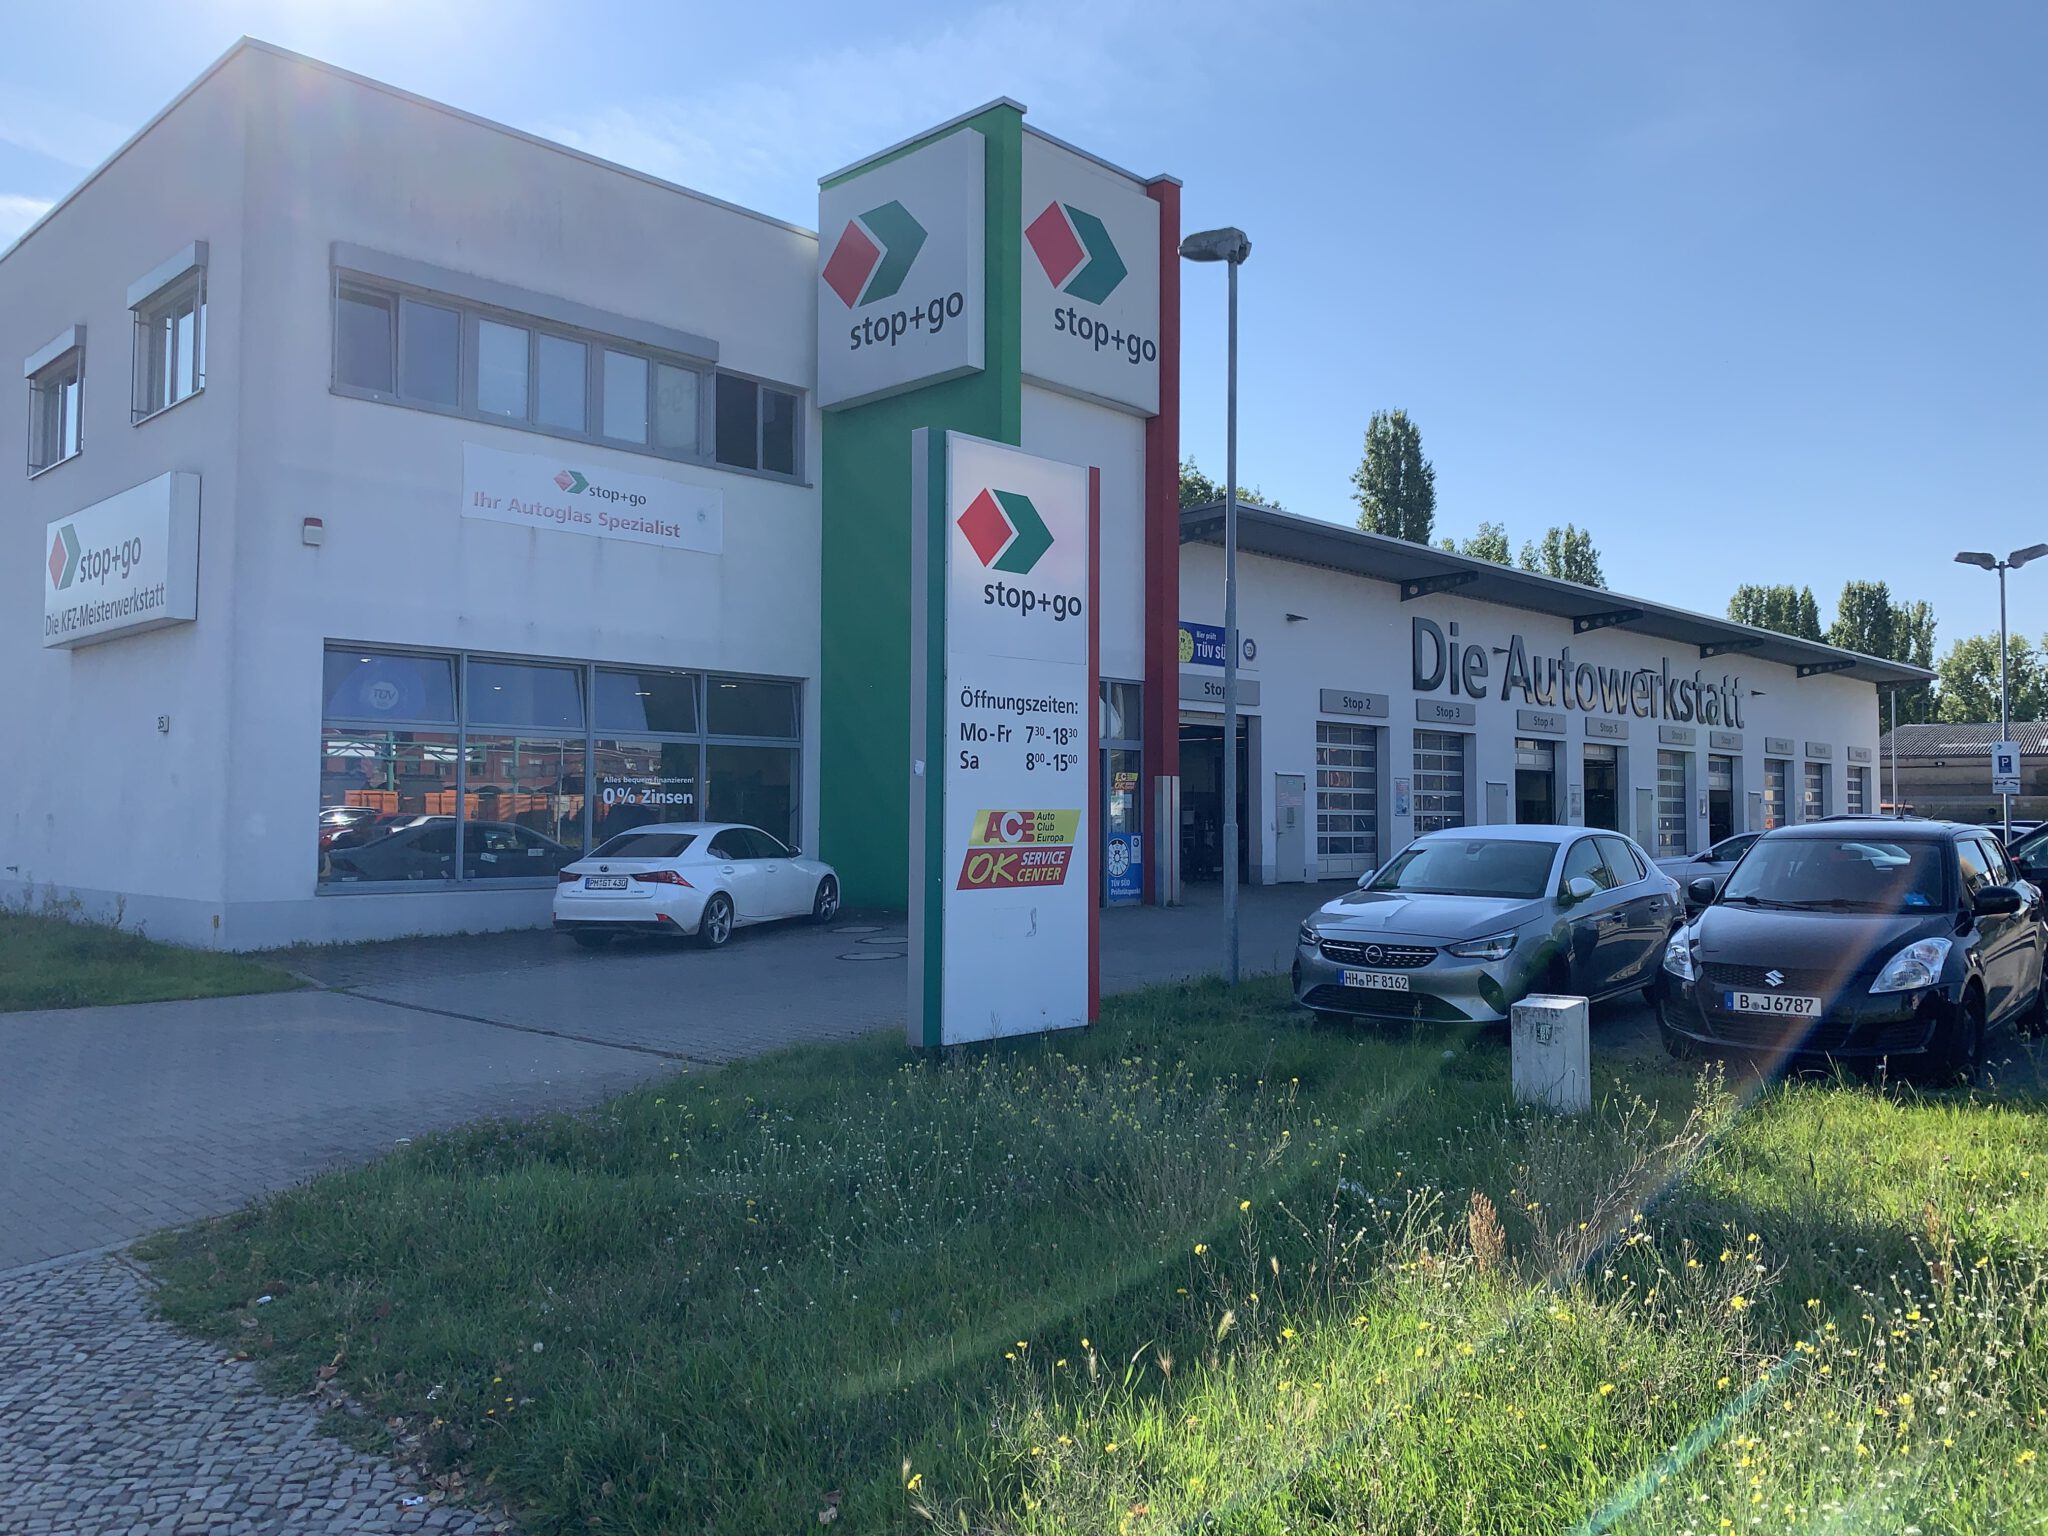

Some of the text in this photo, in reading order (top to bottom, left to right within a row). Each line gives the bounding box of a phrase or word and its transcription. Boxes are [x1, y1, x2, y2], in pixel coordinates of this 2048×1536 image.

[850, 292, 963, 350] stop+go
[1055, 307, 1156, 365] stop+go
[589, 485, 647, 506] stop+go
[473, 491, 681, 538] Ihr Autoglas Spezialist
[80, 537, 141, 585] stop+go
[45, 582, 165, 636] Die KFZ-Meisterwerkstatt
[984, 581, 1082, 622] stop+go
[1196, 641, 1213, 658] TÜV
[1215, 643, 1226, 660] SÜ
[1412, 617, 1745, 728] Die Autowerkstatt
[960, 686, 1078, 715] Öffnungszeiten:
[1343, 696, 1371, 711] Stop 2
[1436, 706, 1460, 719] Stop 3
[1534, 716, 1548, 728] Stop
[1600, 722, 1612, 734] Stop
[960, 750, 979, 770] Sa
[603, 776, 621, 784] Alles
[623, 776, 652, 785] bequem
[602, 787, 693, 804] 0% Zinsen
[1036, 812, 1055, 821] Auto
[984, 811, 1035, 843] ACE
[1036, 822, 1055, 831] Club
[1036, 833, 1064, 843] Europa
[1021, 851, 1066, 866] SERVICE
[967, 853, 1018, 884] OK
[1017, 867, 1062, 882] CENTER
[1345, 972, 1408, 990] HH PF 8162
[1740, 995, 1814, 1013] B J 6787
